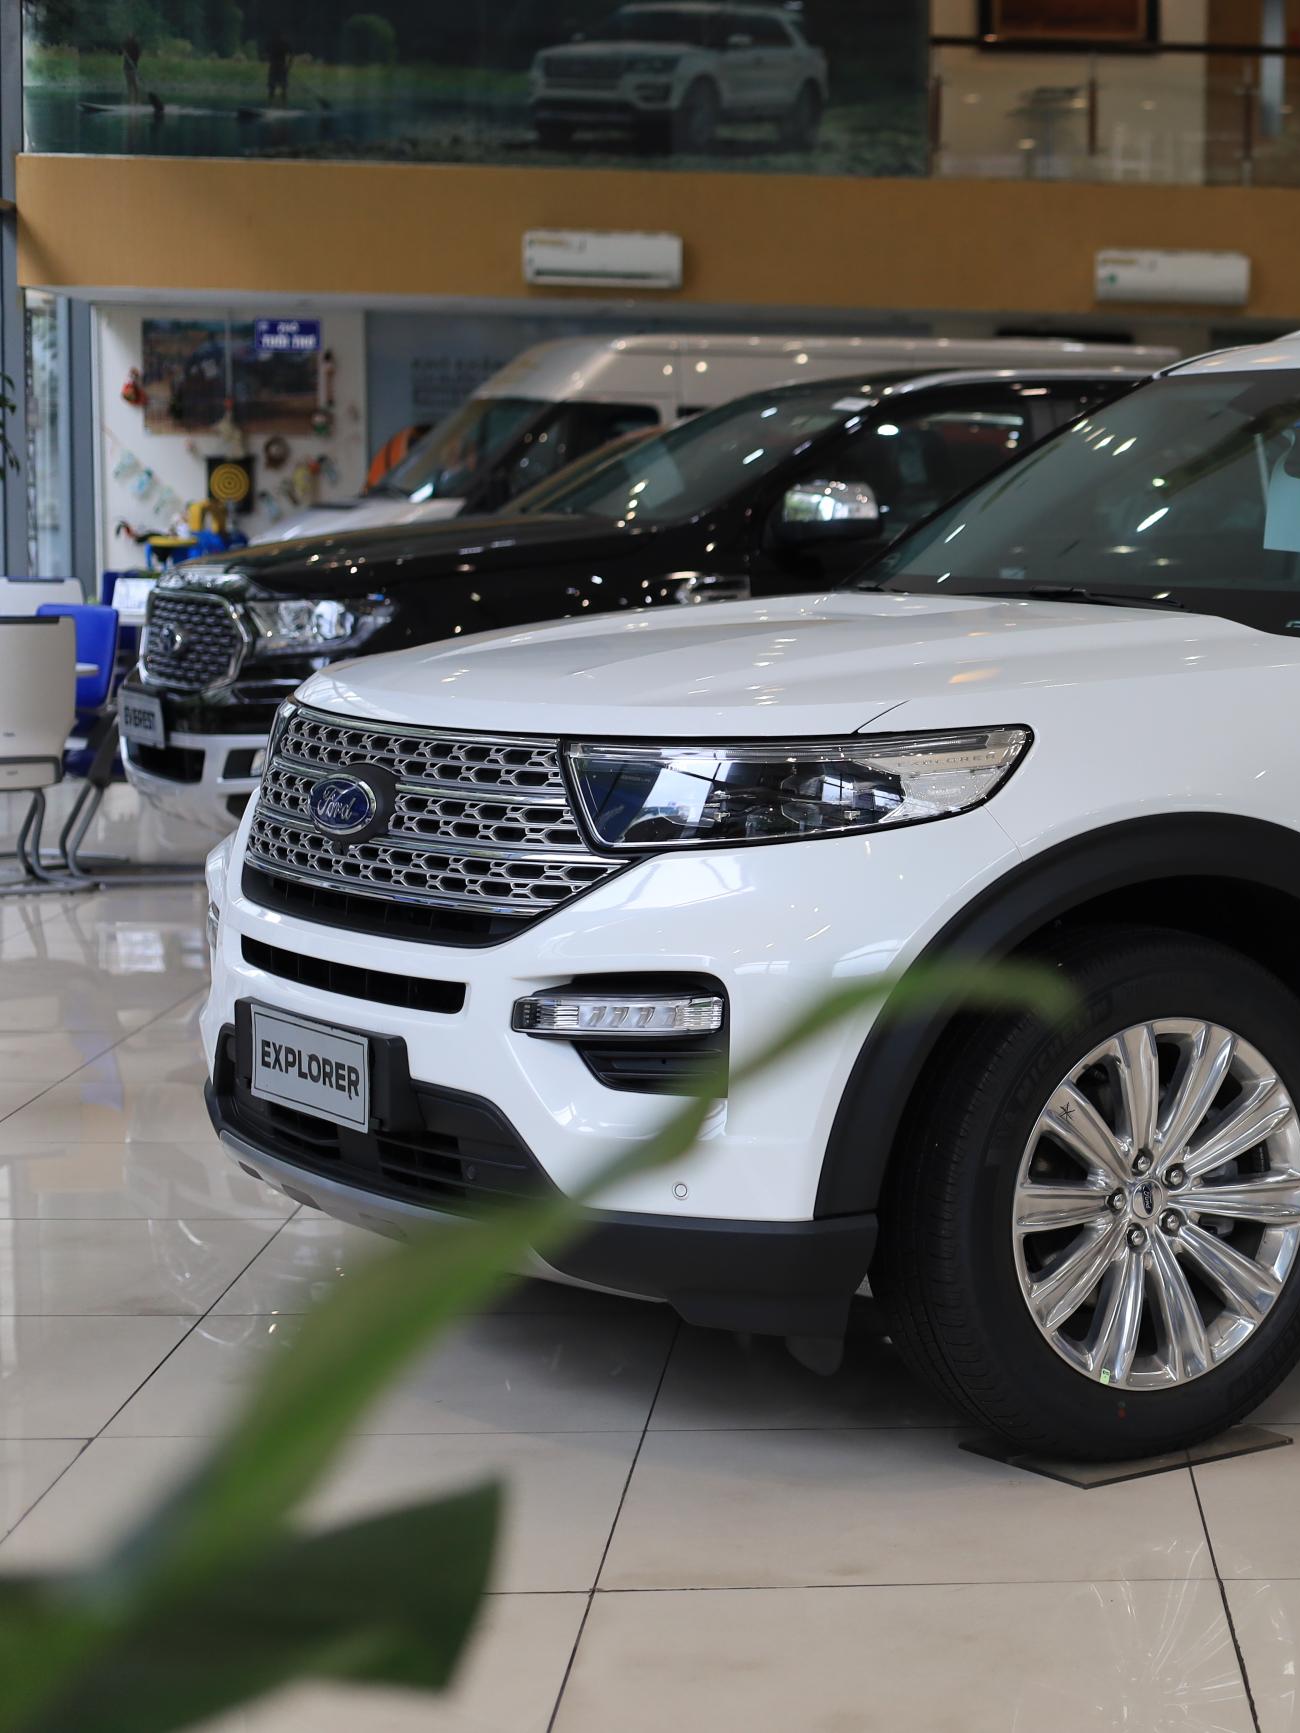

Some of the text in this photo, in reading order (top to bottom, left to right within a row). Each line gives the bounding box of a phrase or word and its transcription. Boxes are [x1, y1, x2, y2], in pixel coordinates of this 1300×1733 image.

[124, 705, 156, 730] EVEREST
[316, 784, 357, 821] Ford
[261, 1039, 360, 1099] EXPLORER
